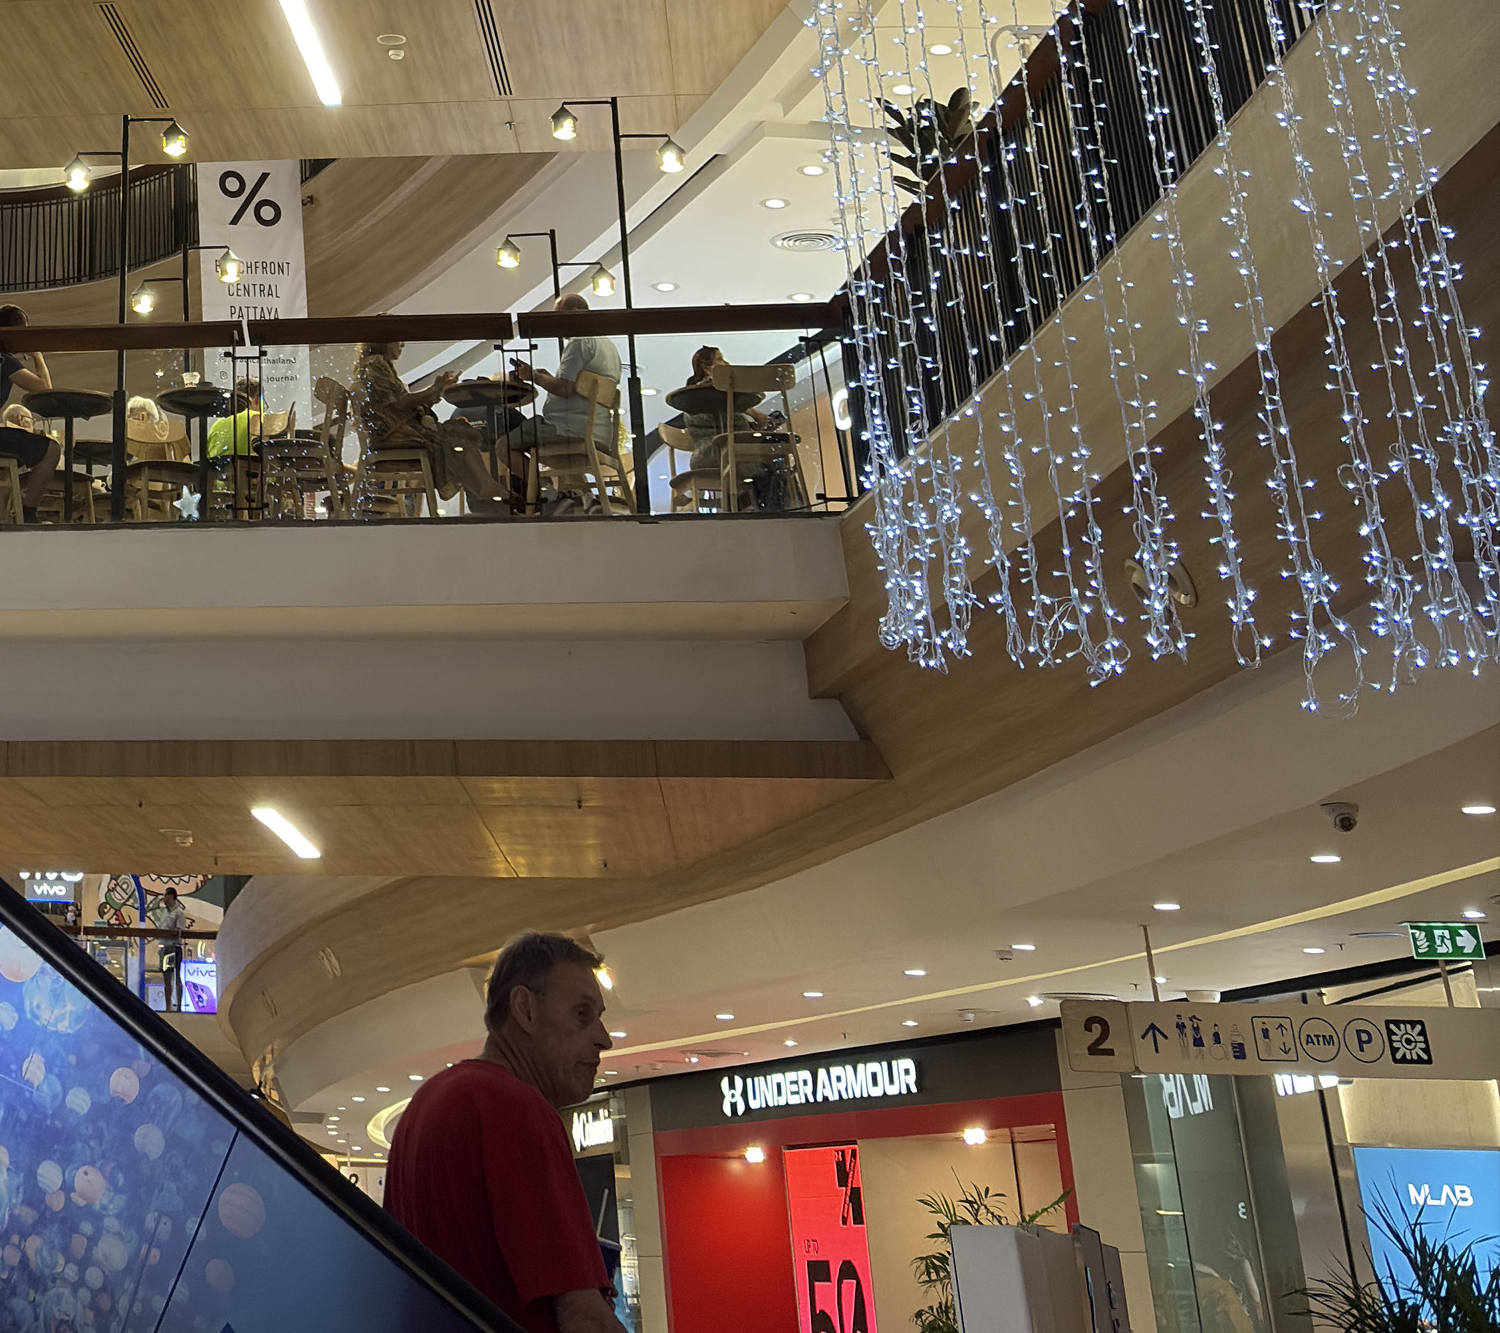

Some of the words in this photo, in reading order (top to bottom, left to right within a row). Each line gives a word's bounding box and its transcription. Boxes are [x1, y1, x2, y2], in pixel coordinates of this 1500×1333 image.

[227, 282, 281, 299] CENTRAL
[229, 305, 280, 321] PATTAYA
[33, 883, 67, 896] vivo
[1083, 1015, 1116, 1057] 2
[1304, 1034, 1336, 1048] ATM
[1355, 1028, 1374, 1053] P
[747, 1070, 815, 1110] UNDER
[816, 1058, 918, 1102] ARMOUR
[1407, 1183, 1474, 1207] MLAB
